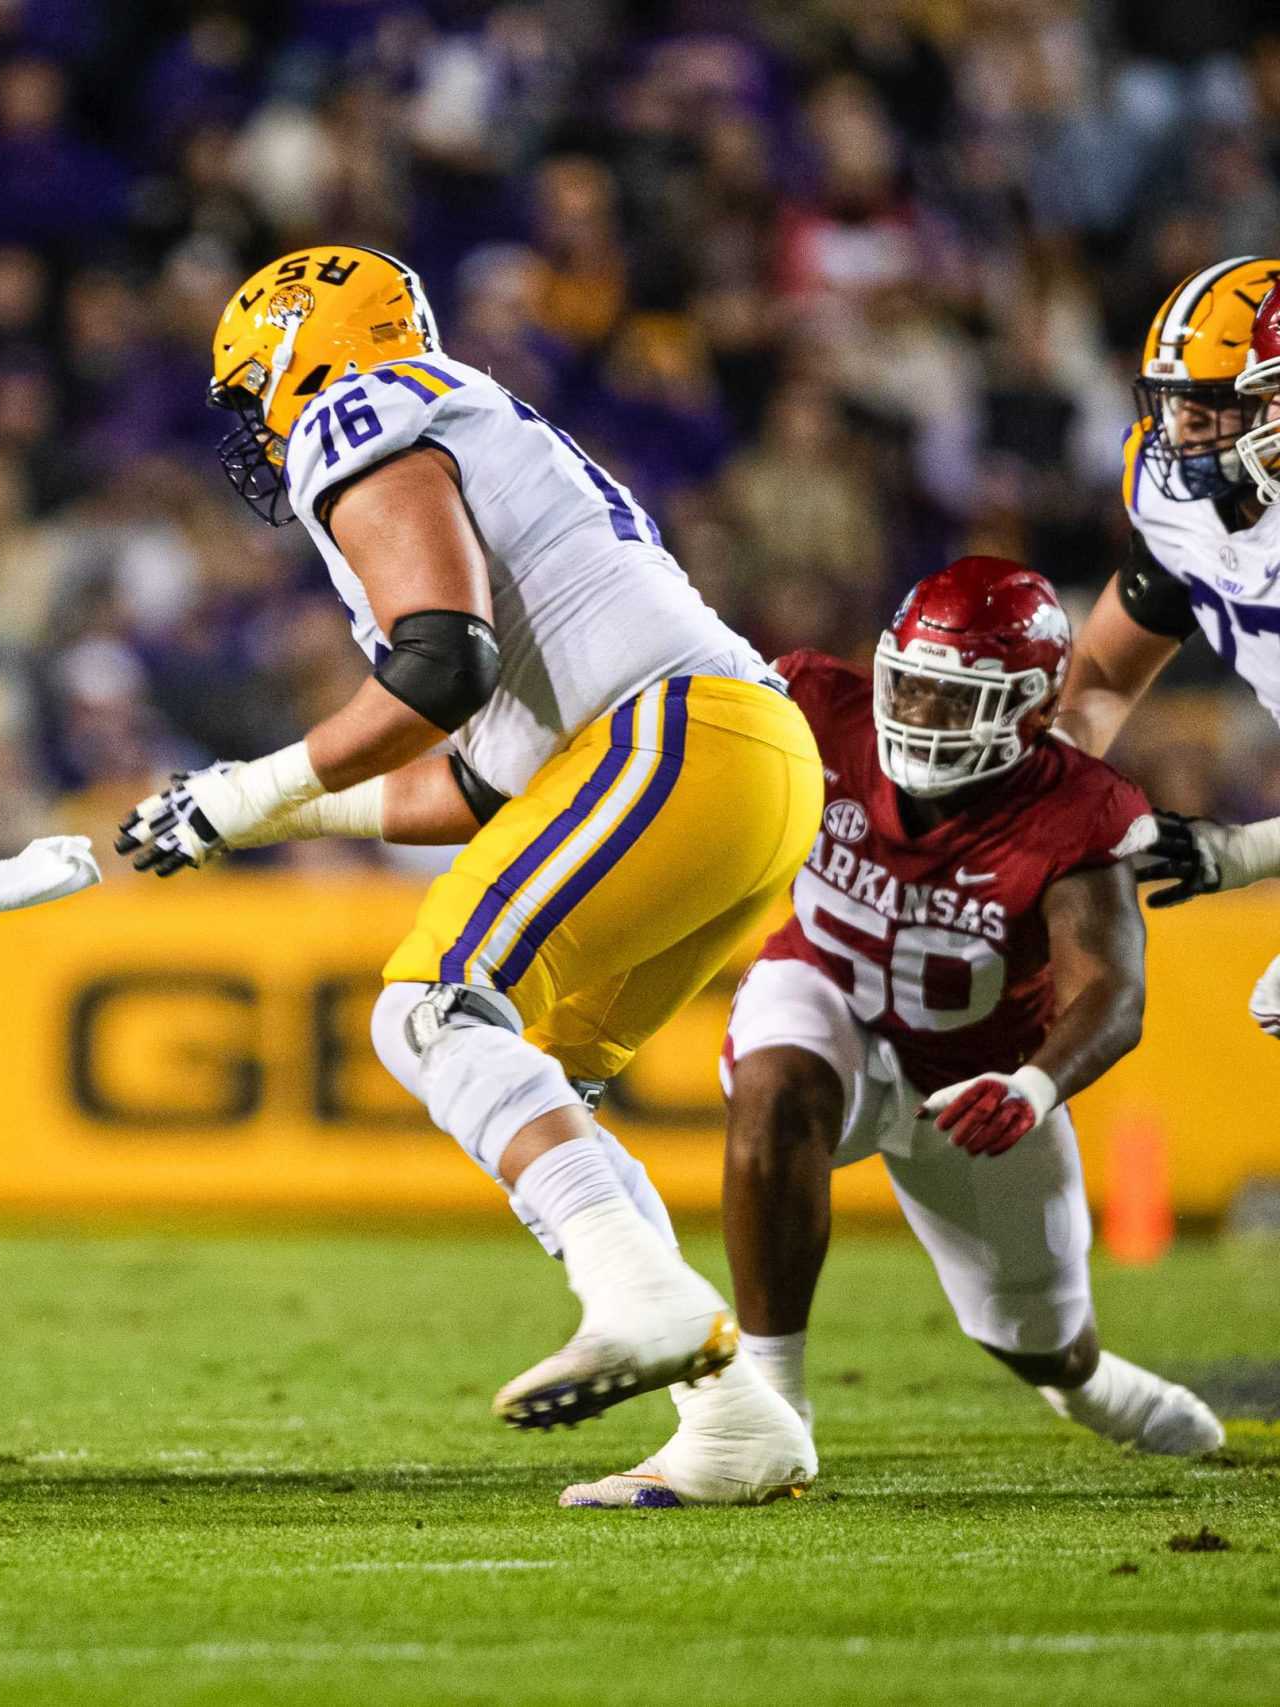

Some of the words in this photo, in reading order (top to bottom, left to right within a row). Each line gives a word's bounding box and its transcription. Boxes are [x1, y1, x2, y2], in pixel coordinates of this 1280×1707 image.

[239, 255, 361, 313] LSU
[303, 386, 384, 469] 76
[826, 803, 866, 841] SEC
[805, 831, 1006, 941] ARKANSAS
[792, 865, 1005, 1033] 50
